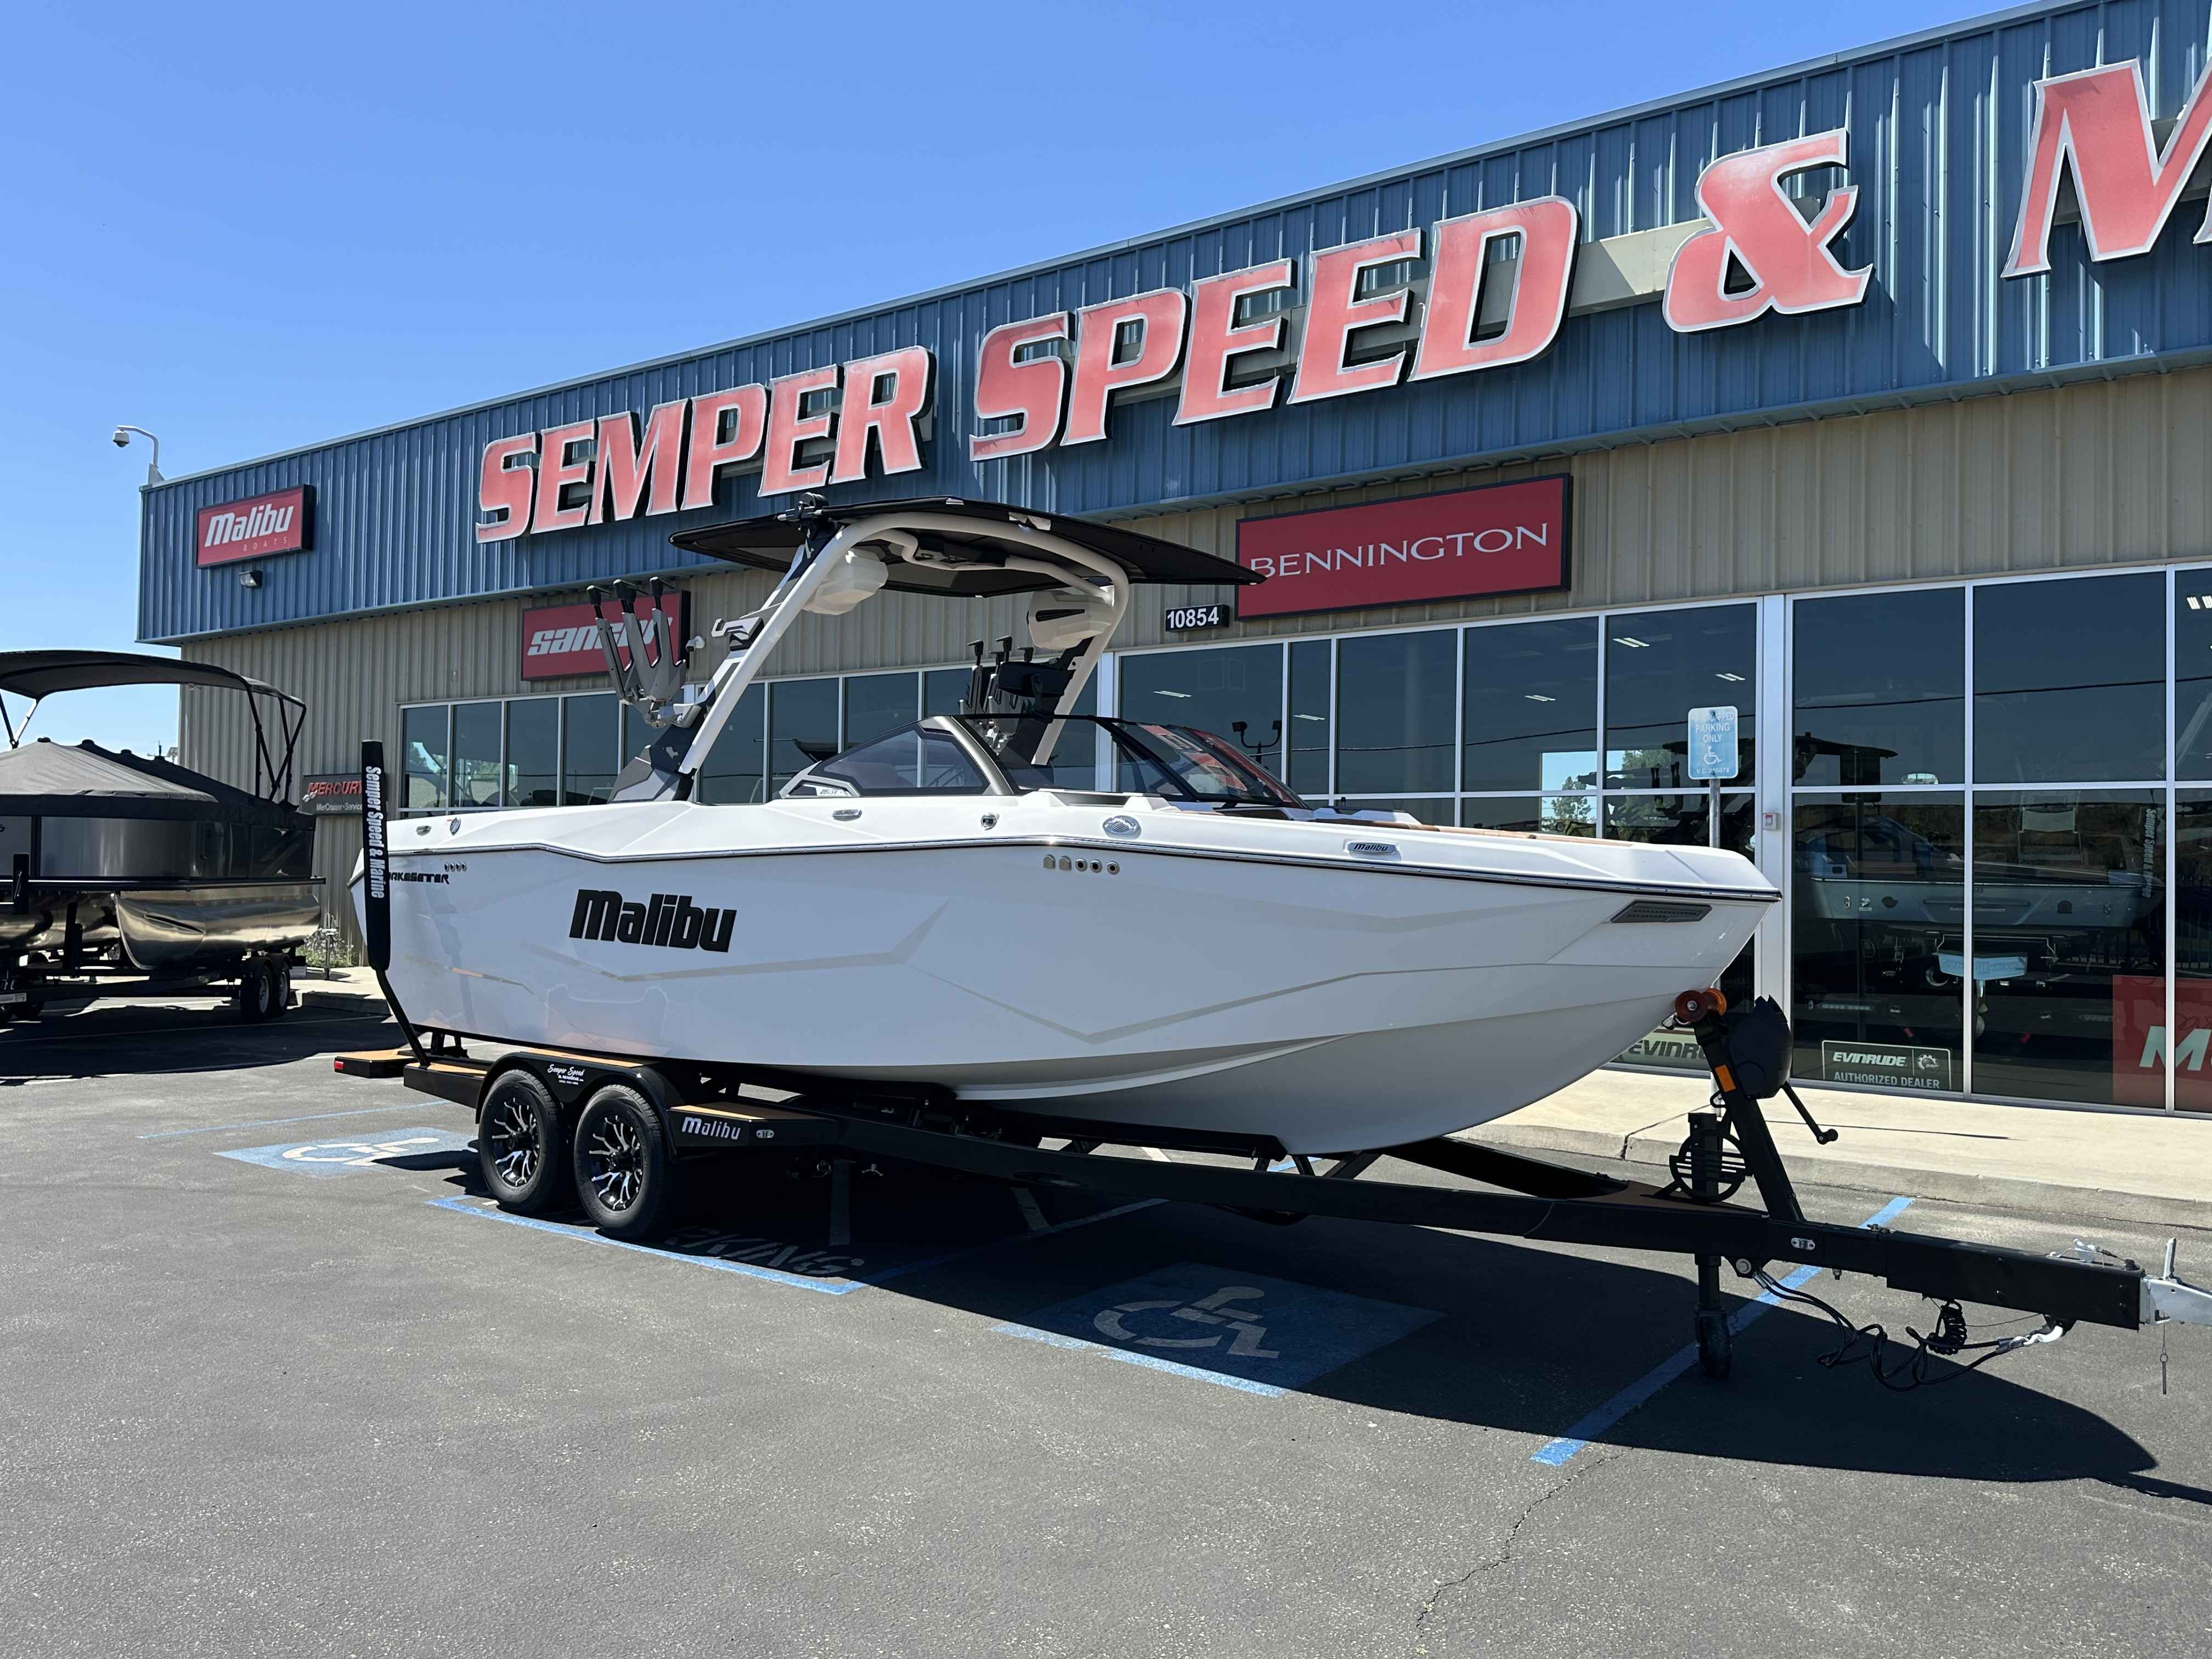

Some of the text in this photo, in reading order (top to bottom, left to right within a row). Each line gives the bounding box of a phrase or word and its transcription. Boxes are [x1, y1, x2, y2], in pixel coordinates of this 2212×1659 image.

[476, 344, 933, 544] SEMPER
[968, 195, 1578, 462] SPEED
[1662, 127, 1874, 333] &
[204, 503, 294, 548] Malibu
[243, 536, 287, 551] BOATS
[1250, 522, 1548, 578] BENNINGTON
[1167, 606, 1219, 629] 10854
[1695, 723, 1730, 733] PARKING
[1702, 733, 1722, 743] ONLY
[365, 766, 386, 899] Semper Speed & Marine
[1353, 843, 1388, 851] Malibu
[569, 889, 737, 953] Malibu
[1628, 1040, 1707, 1059] EVINR
[1833, 1051, 1906, 1067] EVINRUDE
[2139, 1024, 2212, 1071] M
[1834, 1071, 1940, 1089] AUTHORIZED DEALER
[681, 1116, 741, 1140] Malibu
